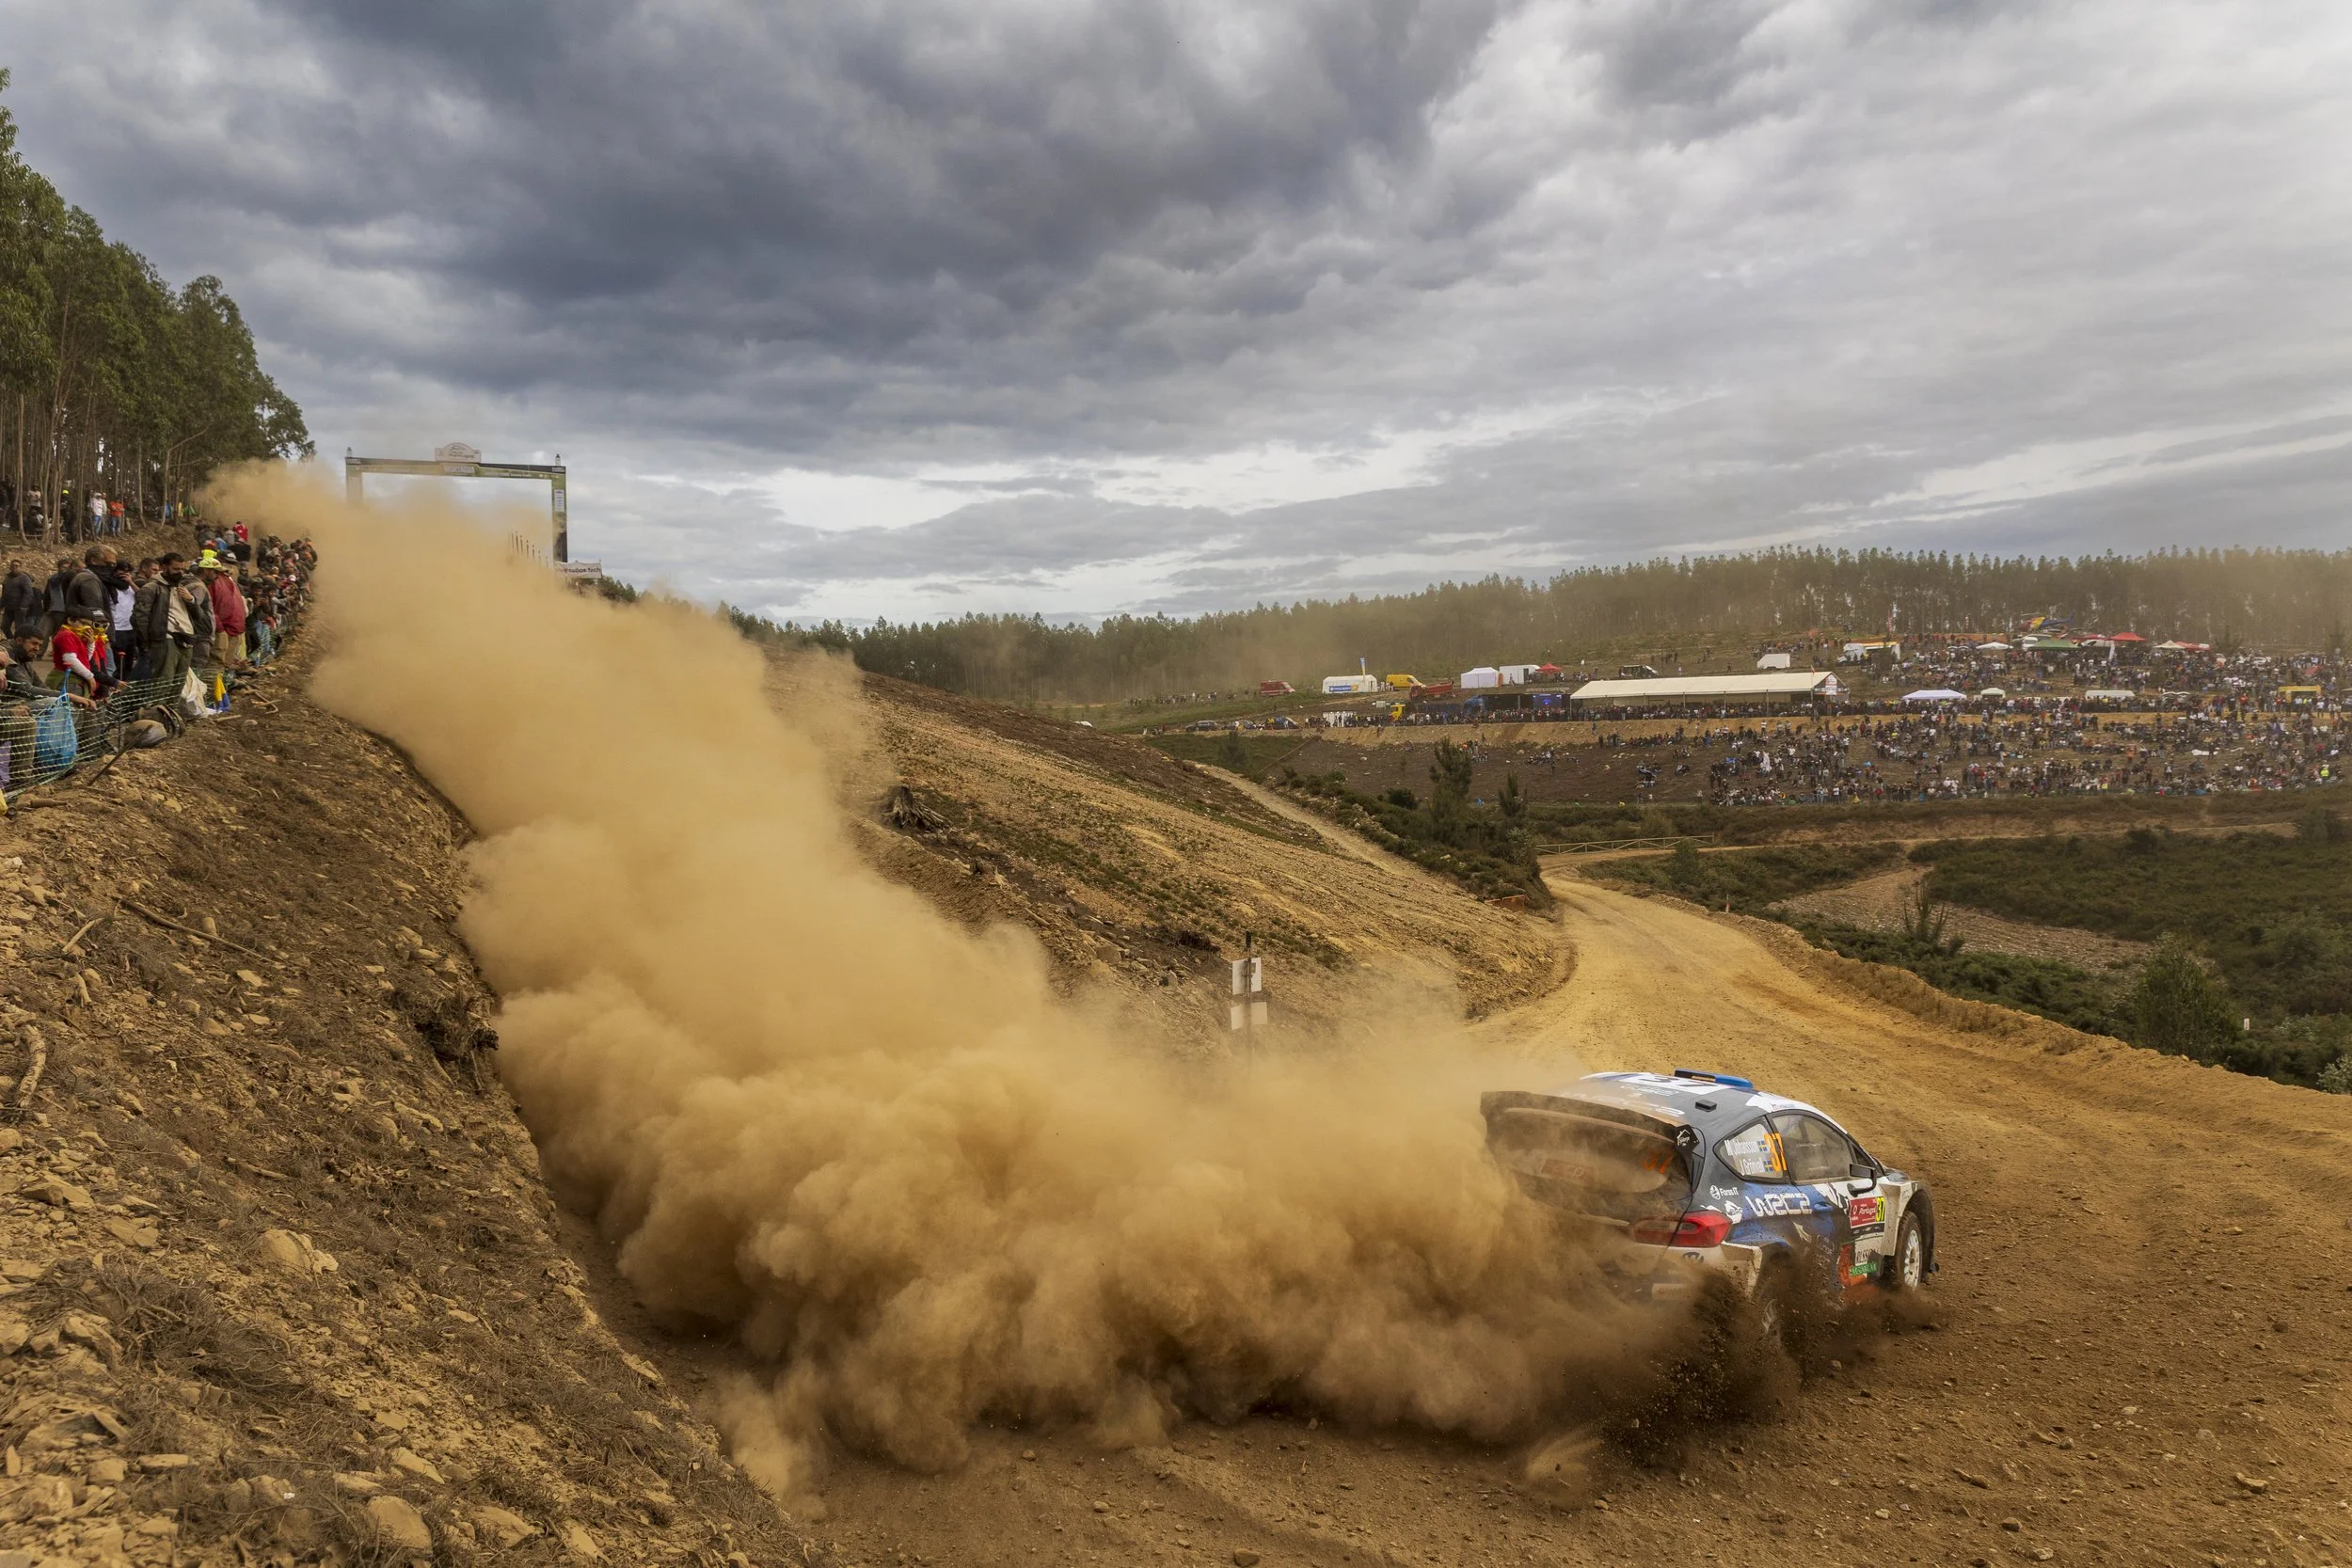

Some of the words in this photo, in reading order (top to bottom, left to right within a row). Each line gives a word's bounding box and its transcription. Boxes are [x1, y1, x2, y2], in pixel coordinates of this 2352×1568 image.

[1639, 1075, 1718, 1087] 37
[1764, 1132, 1787, 1172] 37
[1858, 1207, 1876, 1215] Portugal
[1876, 1196, 1885, 1222] 37
